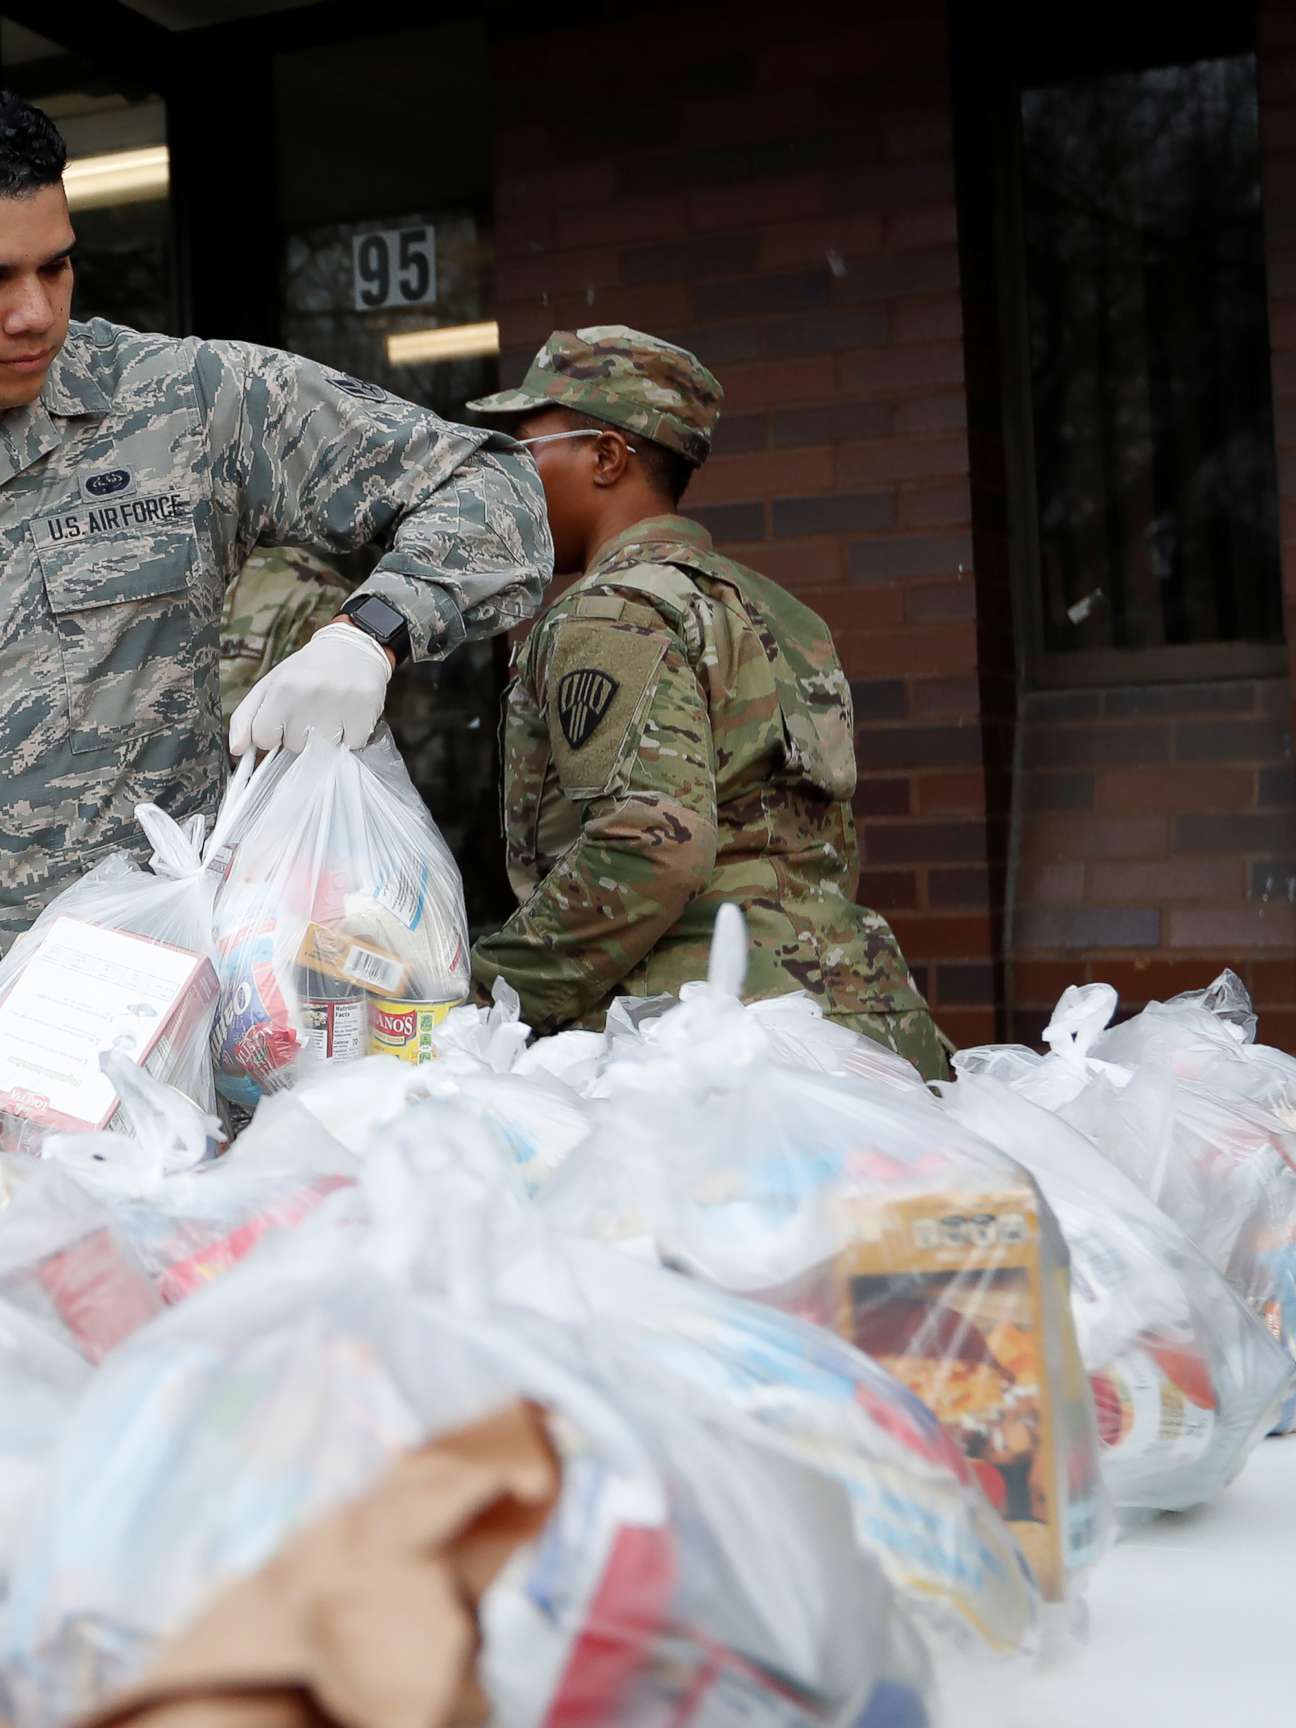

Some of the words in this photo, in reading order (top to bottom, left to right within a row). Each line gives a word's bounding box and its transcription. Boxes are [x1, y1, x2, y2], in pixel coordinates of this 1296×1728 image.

[358, 229, 430, 306] 95
[47, 516, 86, 541] U.S.
[88, 508, 121, 534] AIR
[120, 494, 183, 527] FORCE
